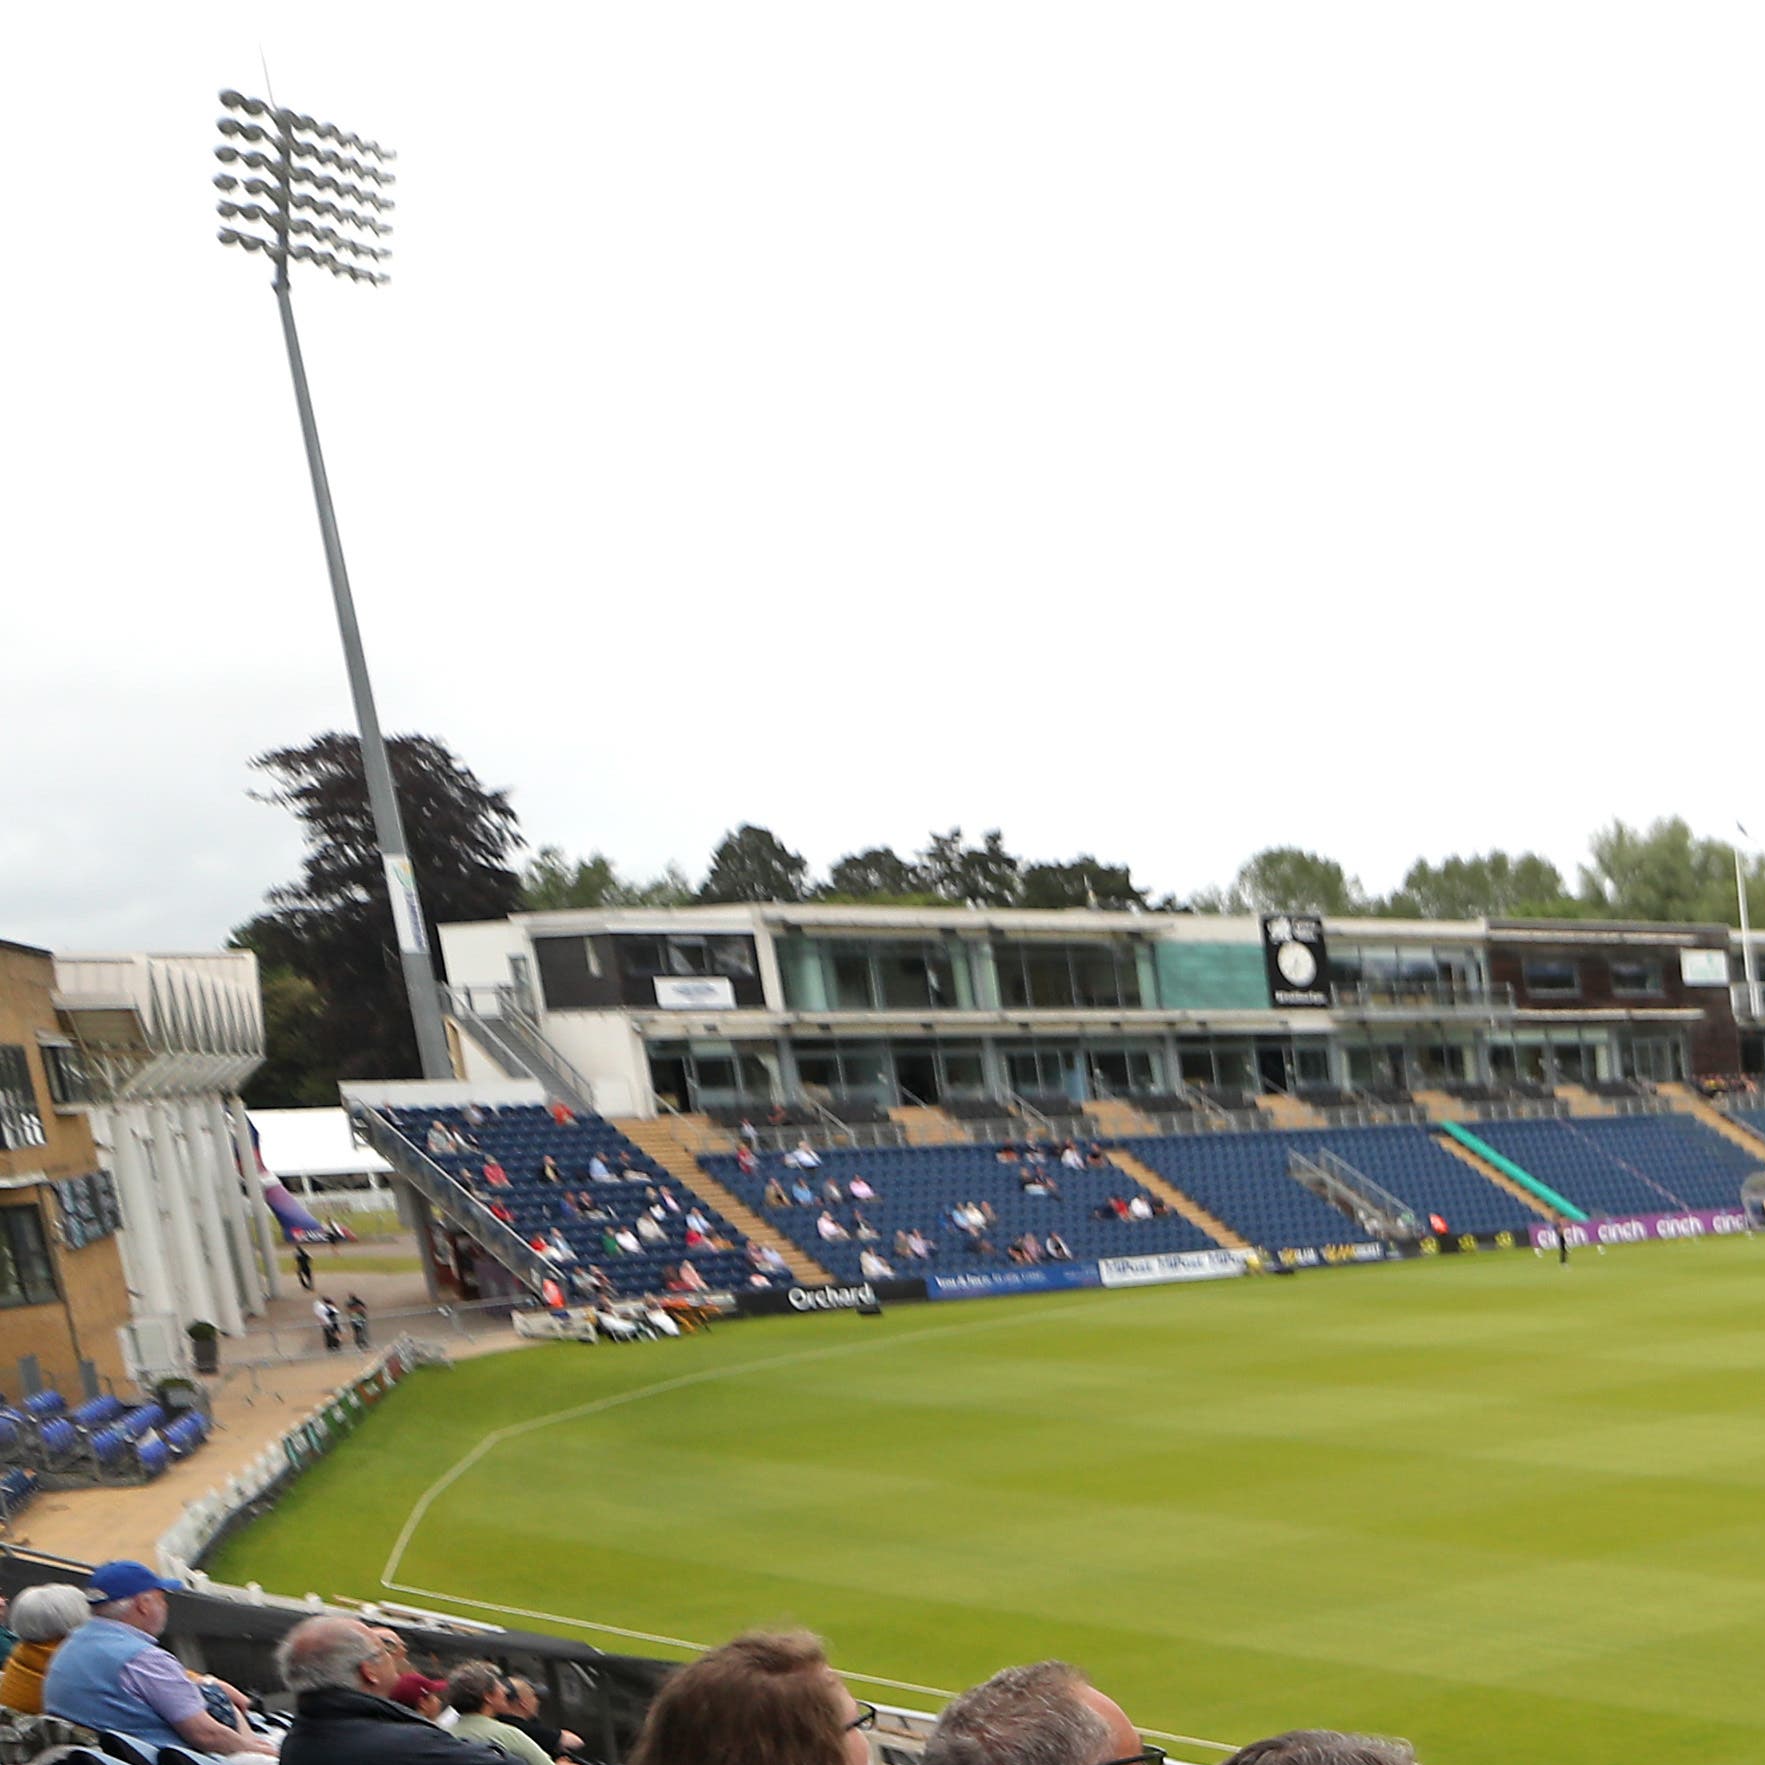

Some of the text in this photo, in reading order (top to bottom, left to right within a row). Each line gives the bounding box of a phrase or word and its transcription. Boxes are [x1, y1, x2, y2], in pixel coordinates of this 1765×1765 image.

[1597, 1216, 1648, 1245] cinch
[1656, 1213, 1705, 1240] cinch
[788, 1281, 876, 1311] Orchard
